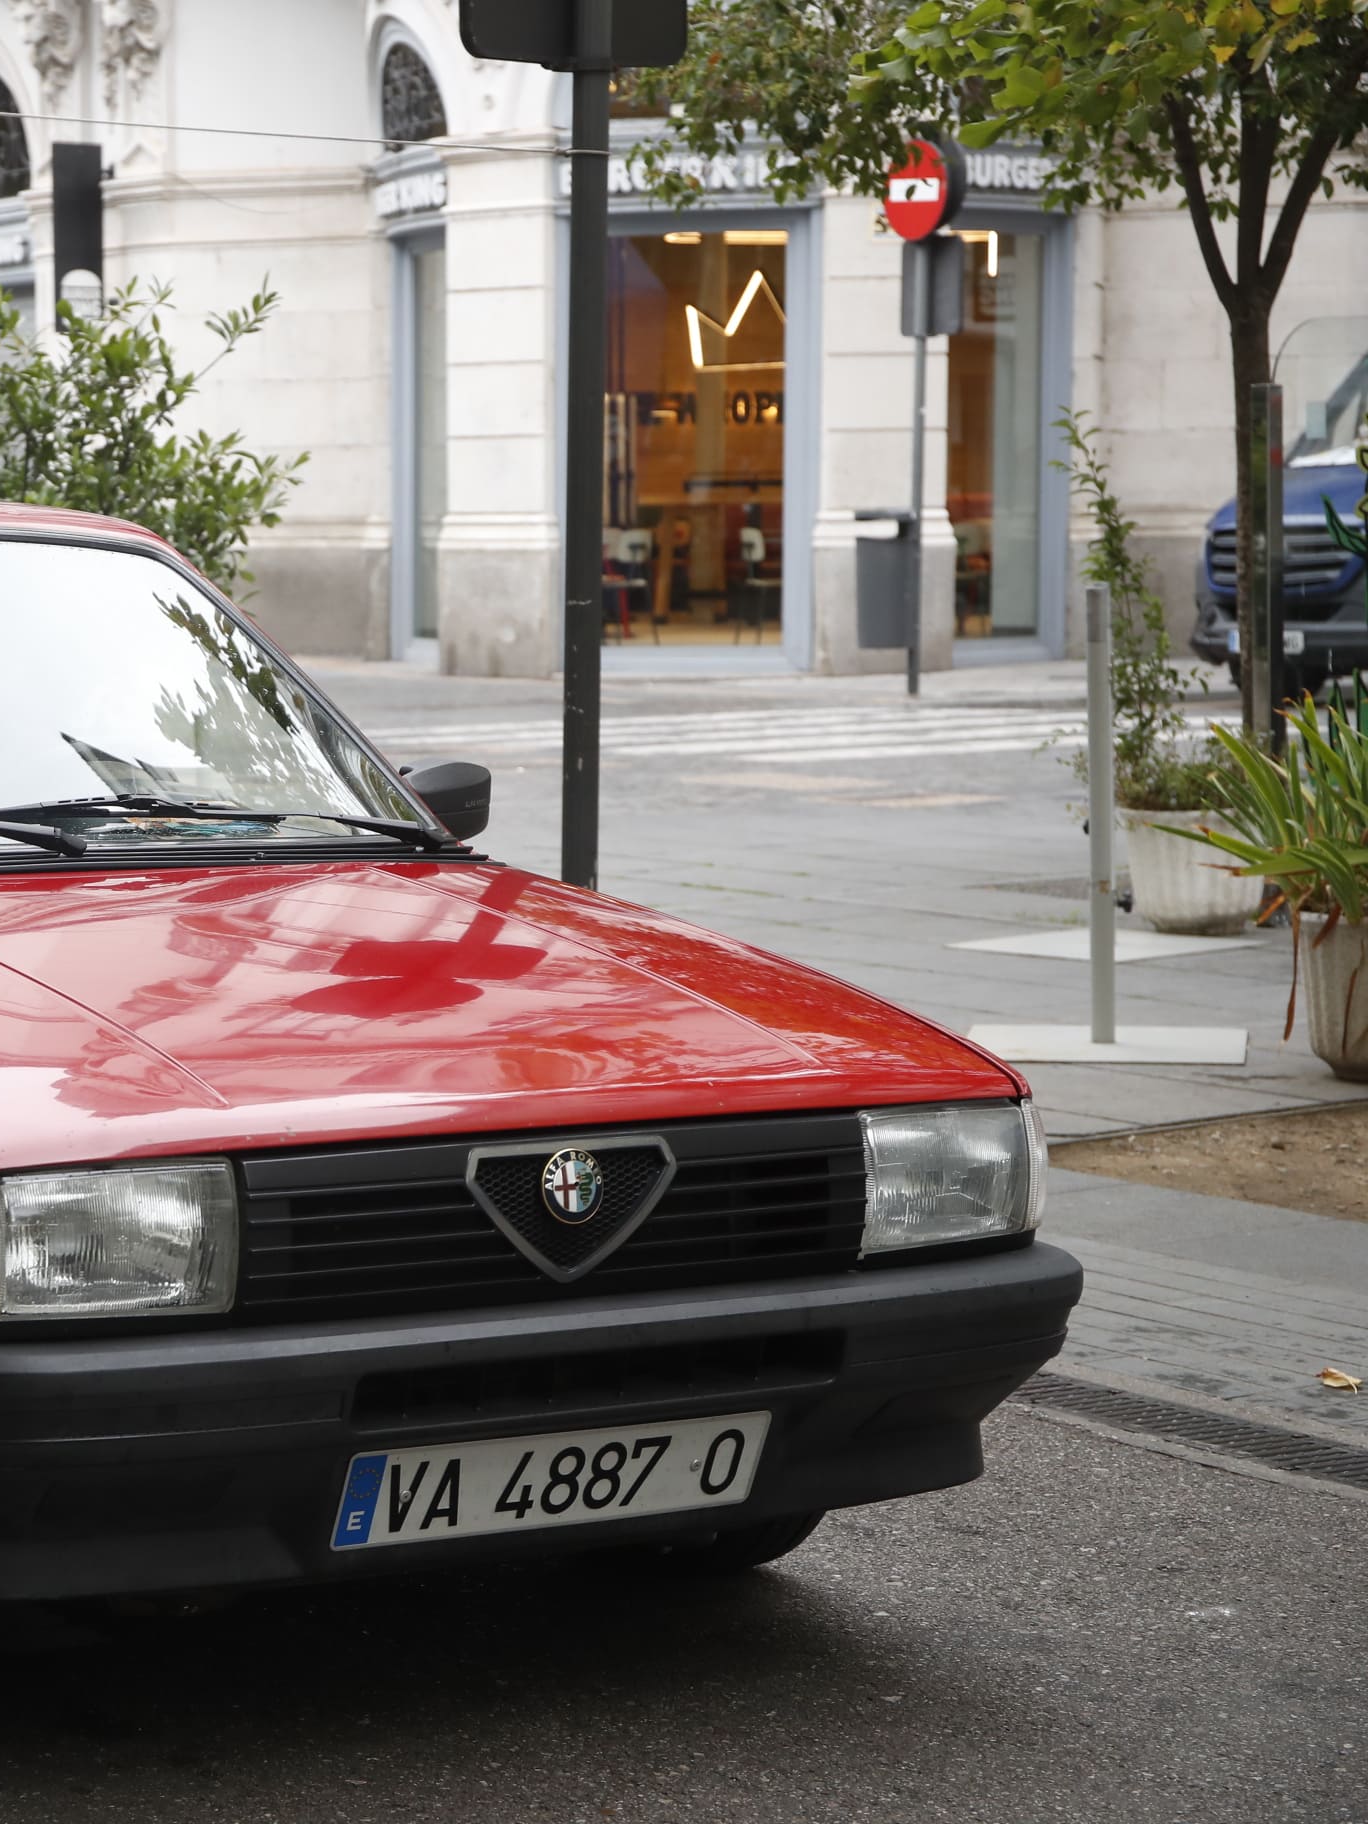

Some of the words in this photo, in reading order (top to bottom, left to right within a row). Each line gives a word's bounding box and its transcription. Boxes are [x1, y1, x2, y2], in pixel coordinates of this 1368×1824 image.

[545, 1156, 566, 1190] ALFA
[569, 1151, 602, 1185] ROMO
[388, 1457, 461, 1533] VA
[494, 1435, 673, 1519] 4887
[345, 1510, 362, 1532] E
